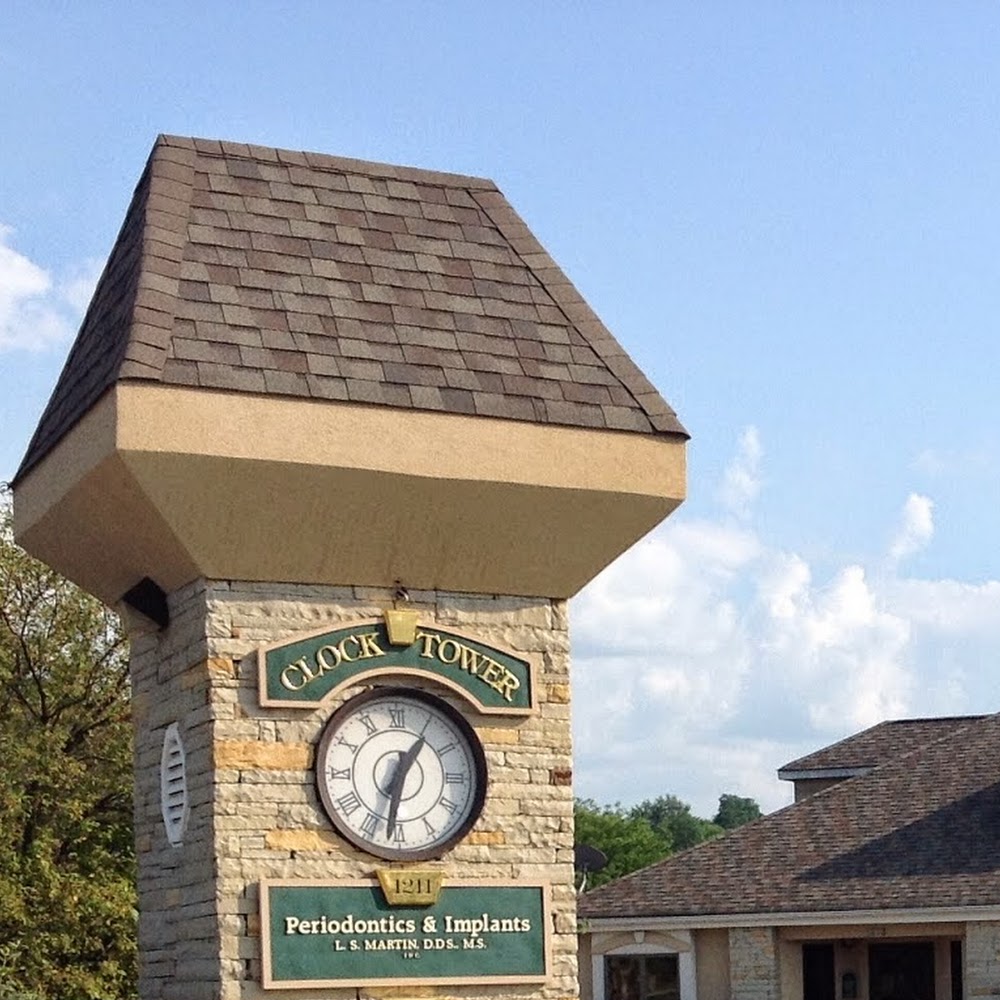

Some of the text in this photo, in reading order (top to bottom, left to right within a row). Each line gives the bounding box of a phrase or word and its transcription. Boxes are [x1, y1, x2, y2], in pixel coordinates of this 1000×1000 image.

[280, 631, 521, 702] CLOCK TOWER
[395, 878, 432, 894] 1211
[285, 913, 532, 937] Periodontics & Implants
